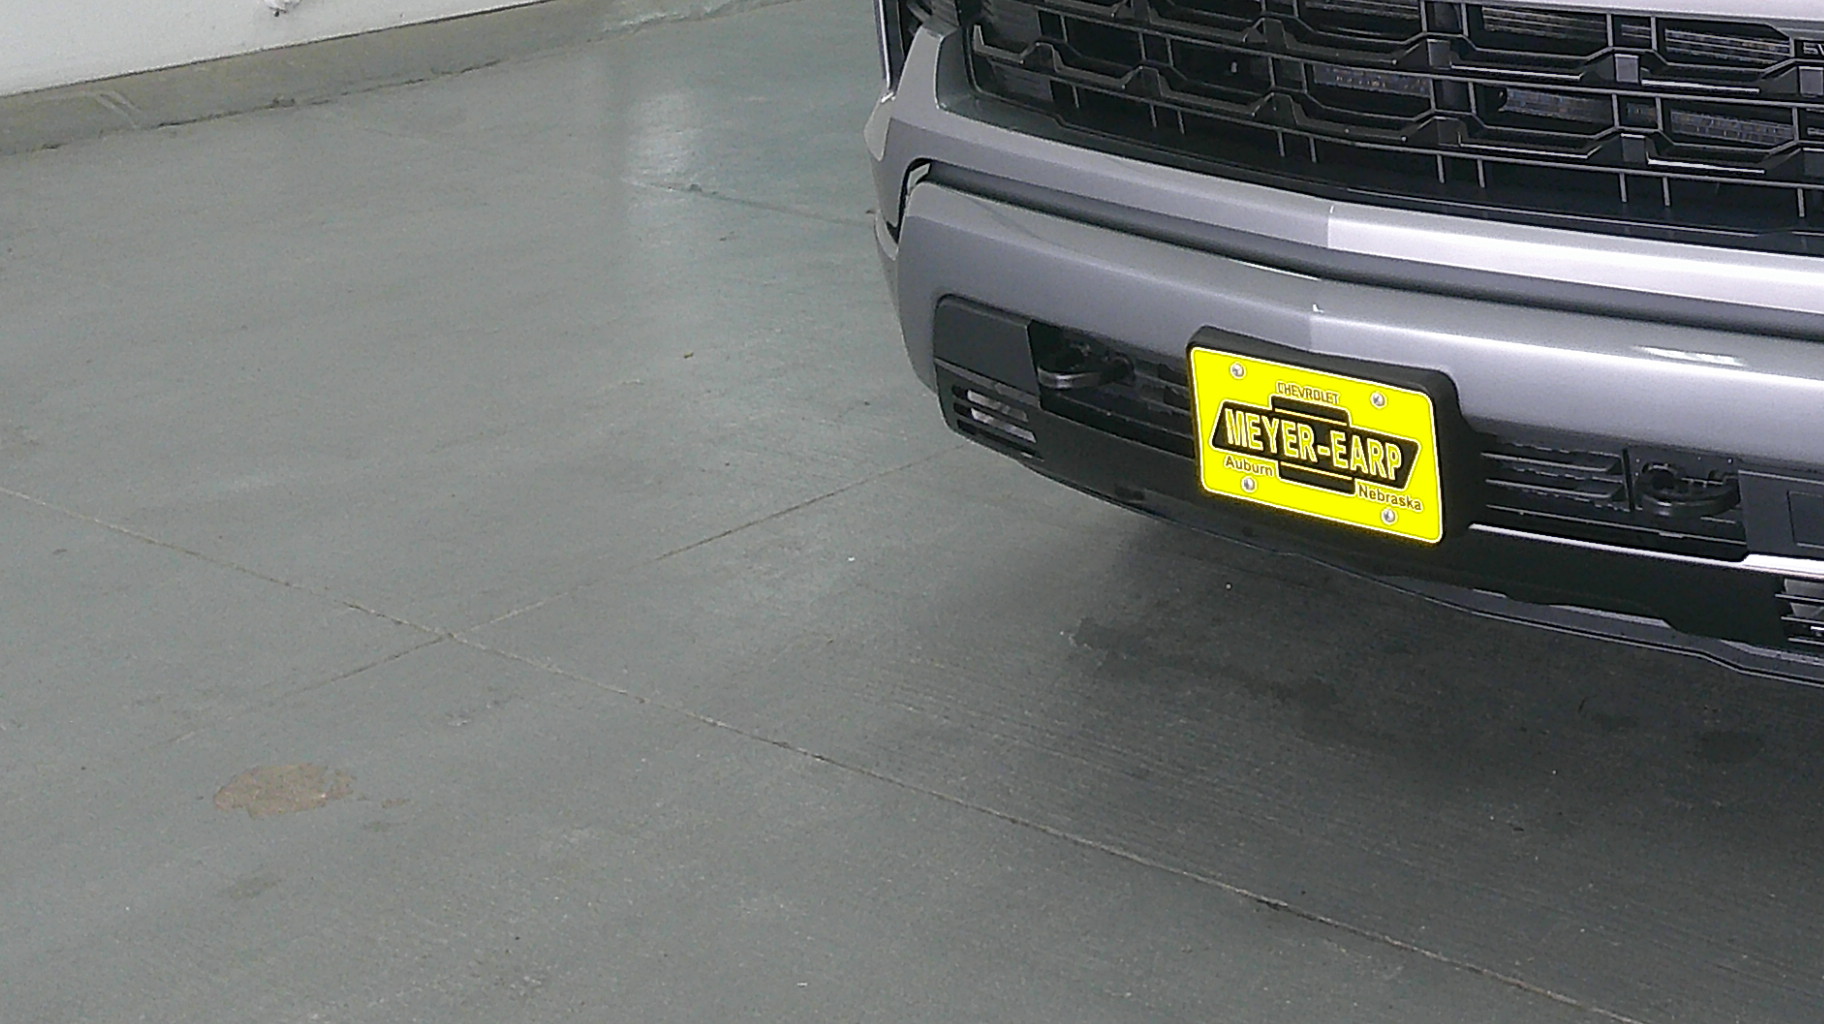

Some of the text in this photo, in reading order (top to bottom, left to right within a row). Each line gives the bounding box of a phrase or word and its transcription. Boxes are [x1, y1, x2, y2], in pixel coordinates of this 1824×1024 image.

[1276, 382, 1340, 404] CHEVROLET
[1223, 408, 1402, 481] MEYER-EARP
[1224, 455, 1273, 477] Auburn
[1358, 484, 1423, 511] Nebraska
